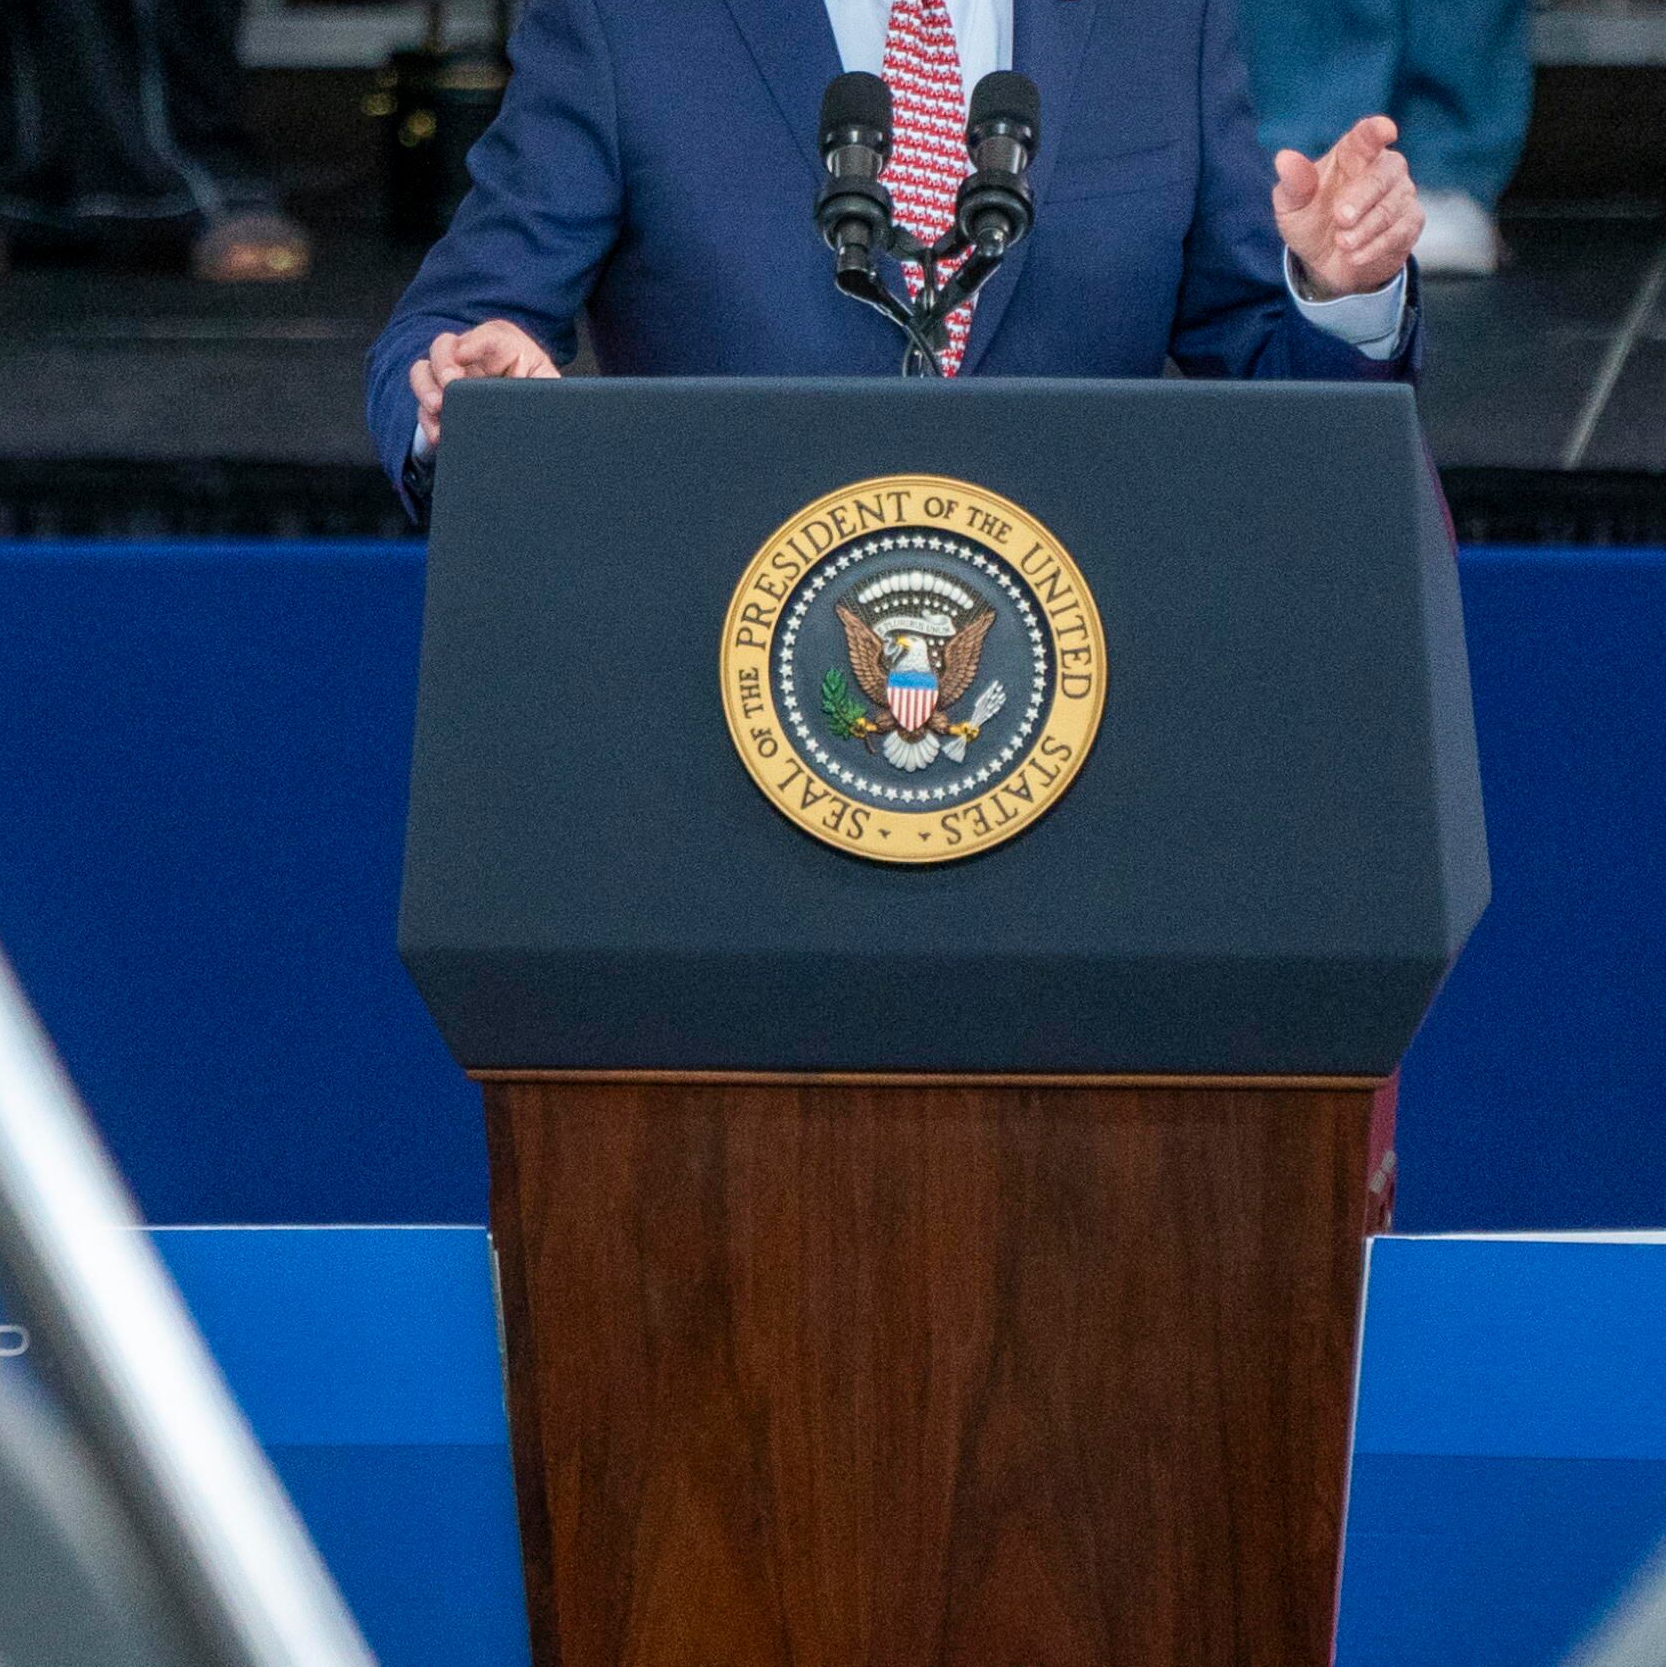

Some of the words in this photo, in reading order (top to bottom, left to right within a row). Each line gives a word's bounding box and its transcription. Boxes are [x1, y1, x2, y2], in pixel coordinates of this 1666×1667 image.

[923, 496, 959, 519] OF
[967, 507, 1012, 544] THE
[735, 491, 910, 651] PRESIDENT
[1020, 542, 1093, 700] UNITED
[738, 666, 767, 720] THE
[749, 727, 779, 760] OF
[776, 758, 871, 841] SEAL
[939, 734, 1073, 846] STATES
